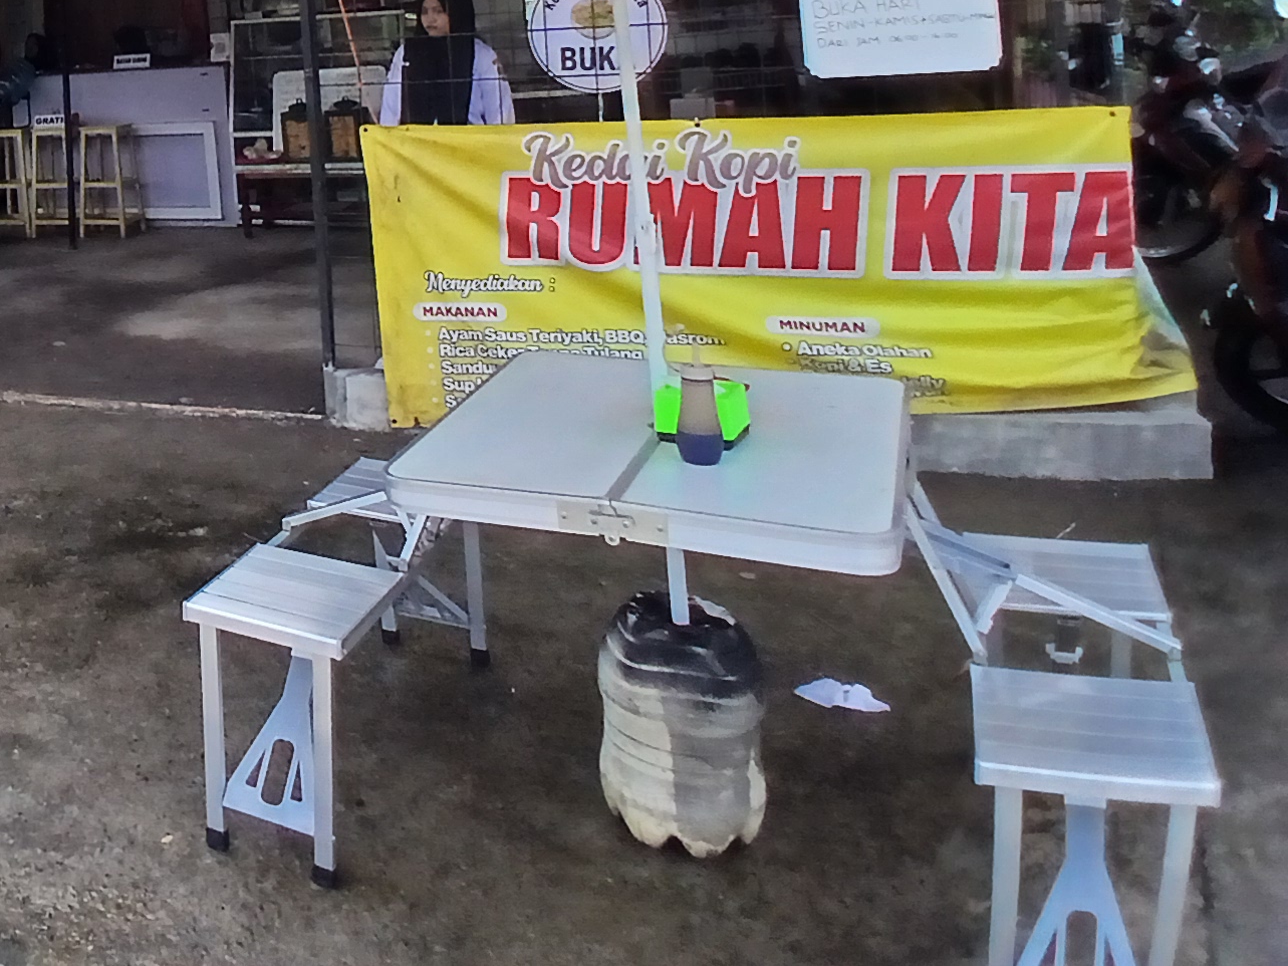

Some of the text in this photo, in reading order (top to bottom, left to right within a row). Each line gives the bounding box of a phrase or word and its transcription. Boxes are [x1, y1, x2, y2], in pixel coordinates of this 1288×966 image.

[812, 0, 867, 19] BUKA
[561, 46, 627, 71] BUK
[35, 117, 64, 125] GRATI
[676, 131, 799, 195] Kopi
[506, 170, 1135, 272] RUMAH KITA
[424, 270, 543, 296] Menyediakan
[422, 306, 498, 318] MAKANAN
[779, 319, 866, 333] MINUMAN
[439, 326, 483, 343] Ayam
[484, 327, 527, 343] Saus
[528, 329, 603, 345] Teriyaki,
[439, 343, 475, 358] Rica
[797, 341, 933, 359] Aneka Olahan
[865, 359, 893, 374] Es
[442, 377, 476, 394] Sup
